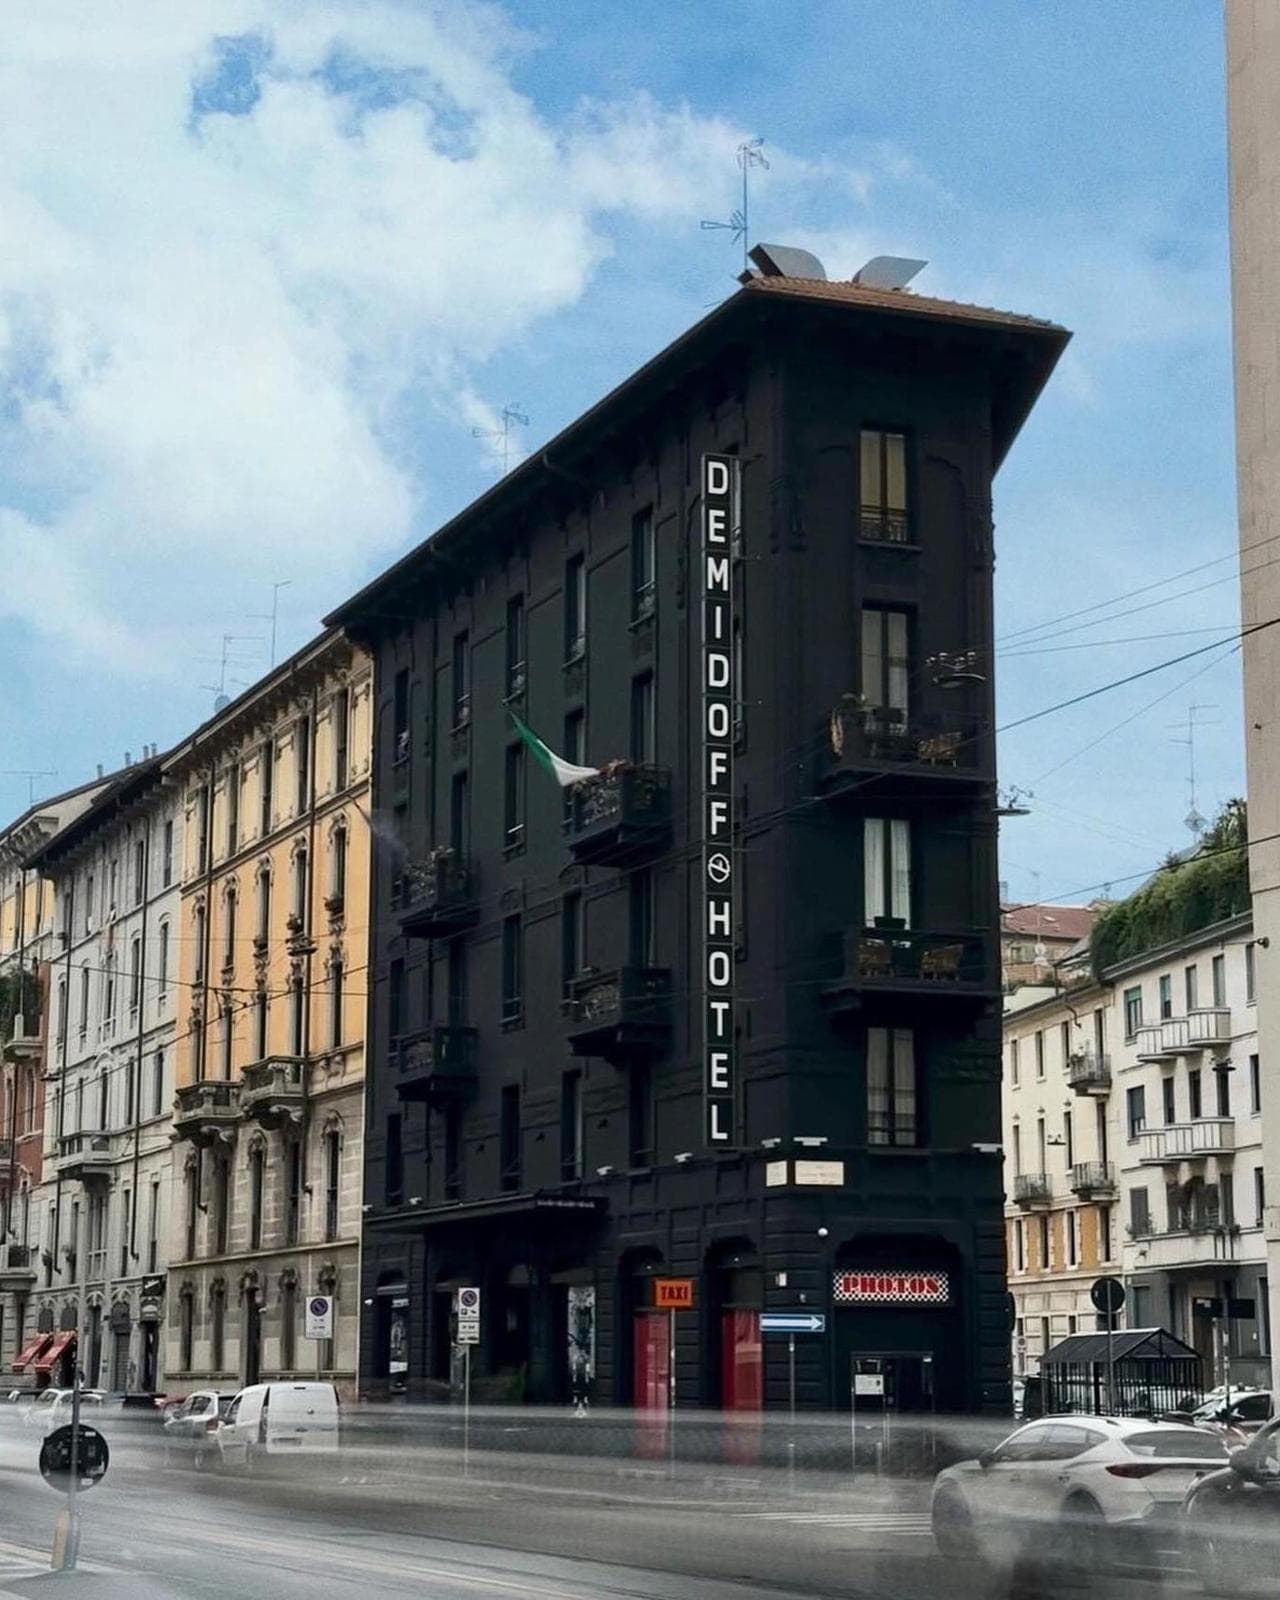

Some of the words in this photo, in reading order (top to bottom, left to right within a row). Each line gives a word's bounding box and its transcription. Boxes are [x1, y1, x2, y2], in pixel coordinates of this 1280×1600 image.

[706, 461, 730, 835] DEMIDOFF
[708, 900, 731, 1140] HOTEL
[661, 1286, 688, 1300] TAXI
[842, 1277, 940, 1294] PHOTOS
